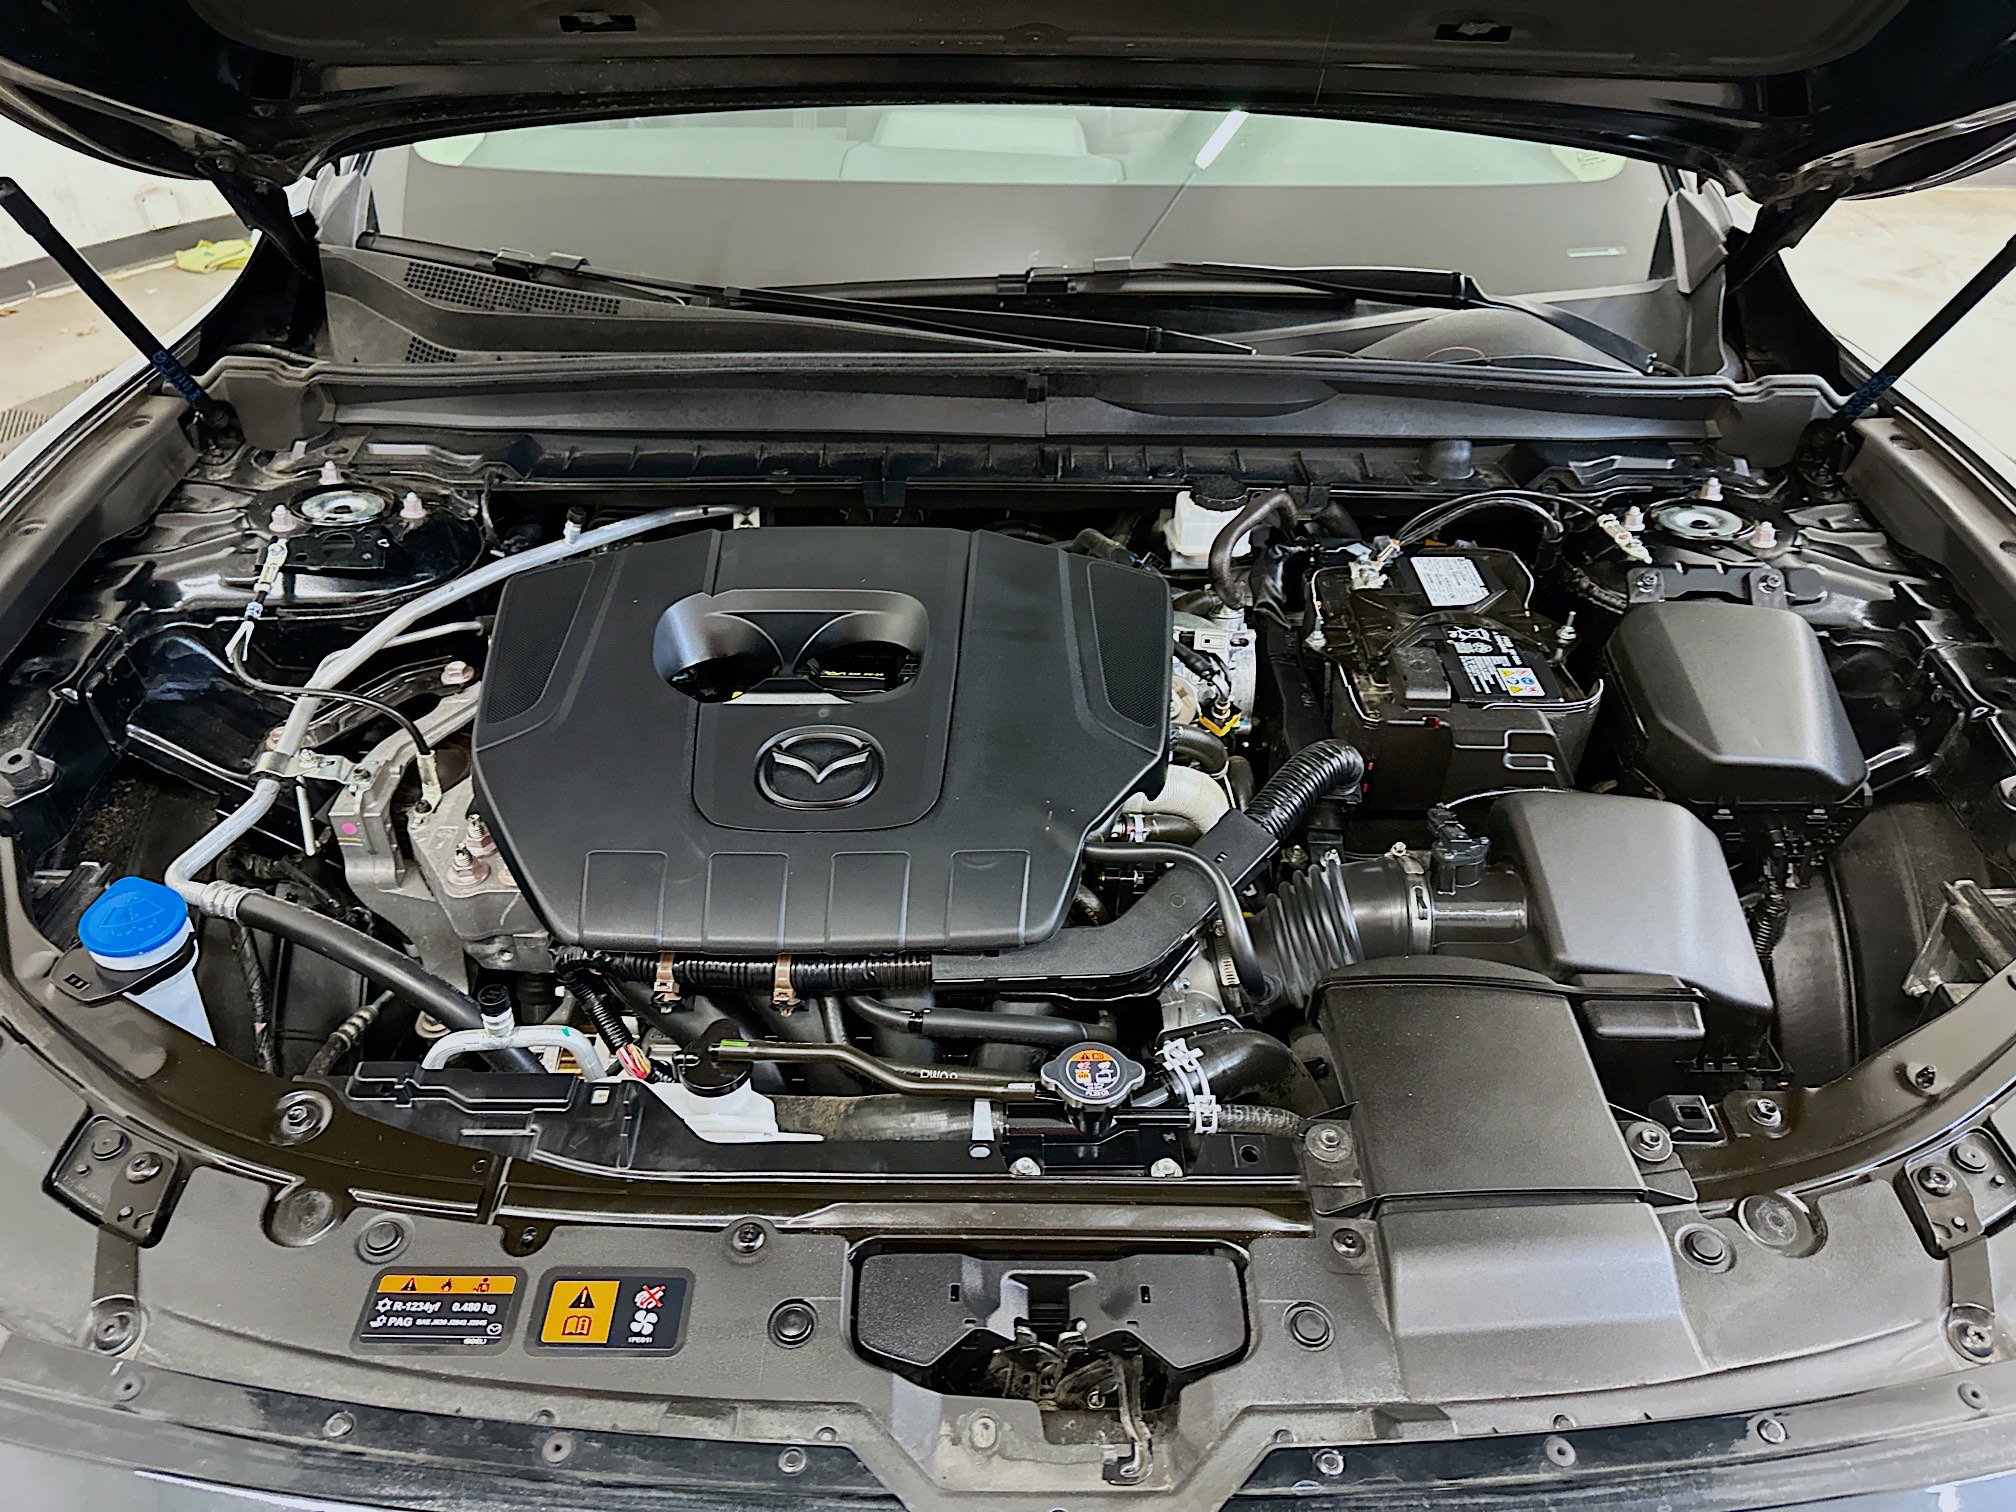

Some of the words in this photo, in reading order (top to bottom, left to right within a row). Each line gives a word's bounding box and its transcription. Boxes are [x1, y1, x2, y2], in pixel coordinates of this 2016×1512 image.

[392, 1301, 441, 1313] R-1234yf
[482, 1302, 497, 1314] kg
[387, 1317, 414, 1327] PAG
